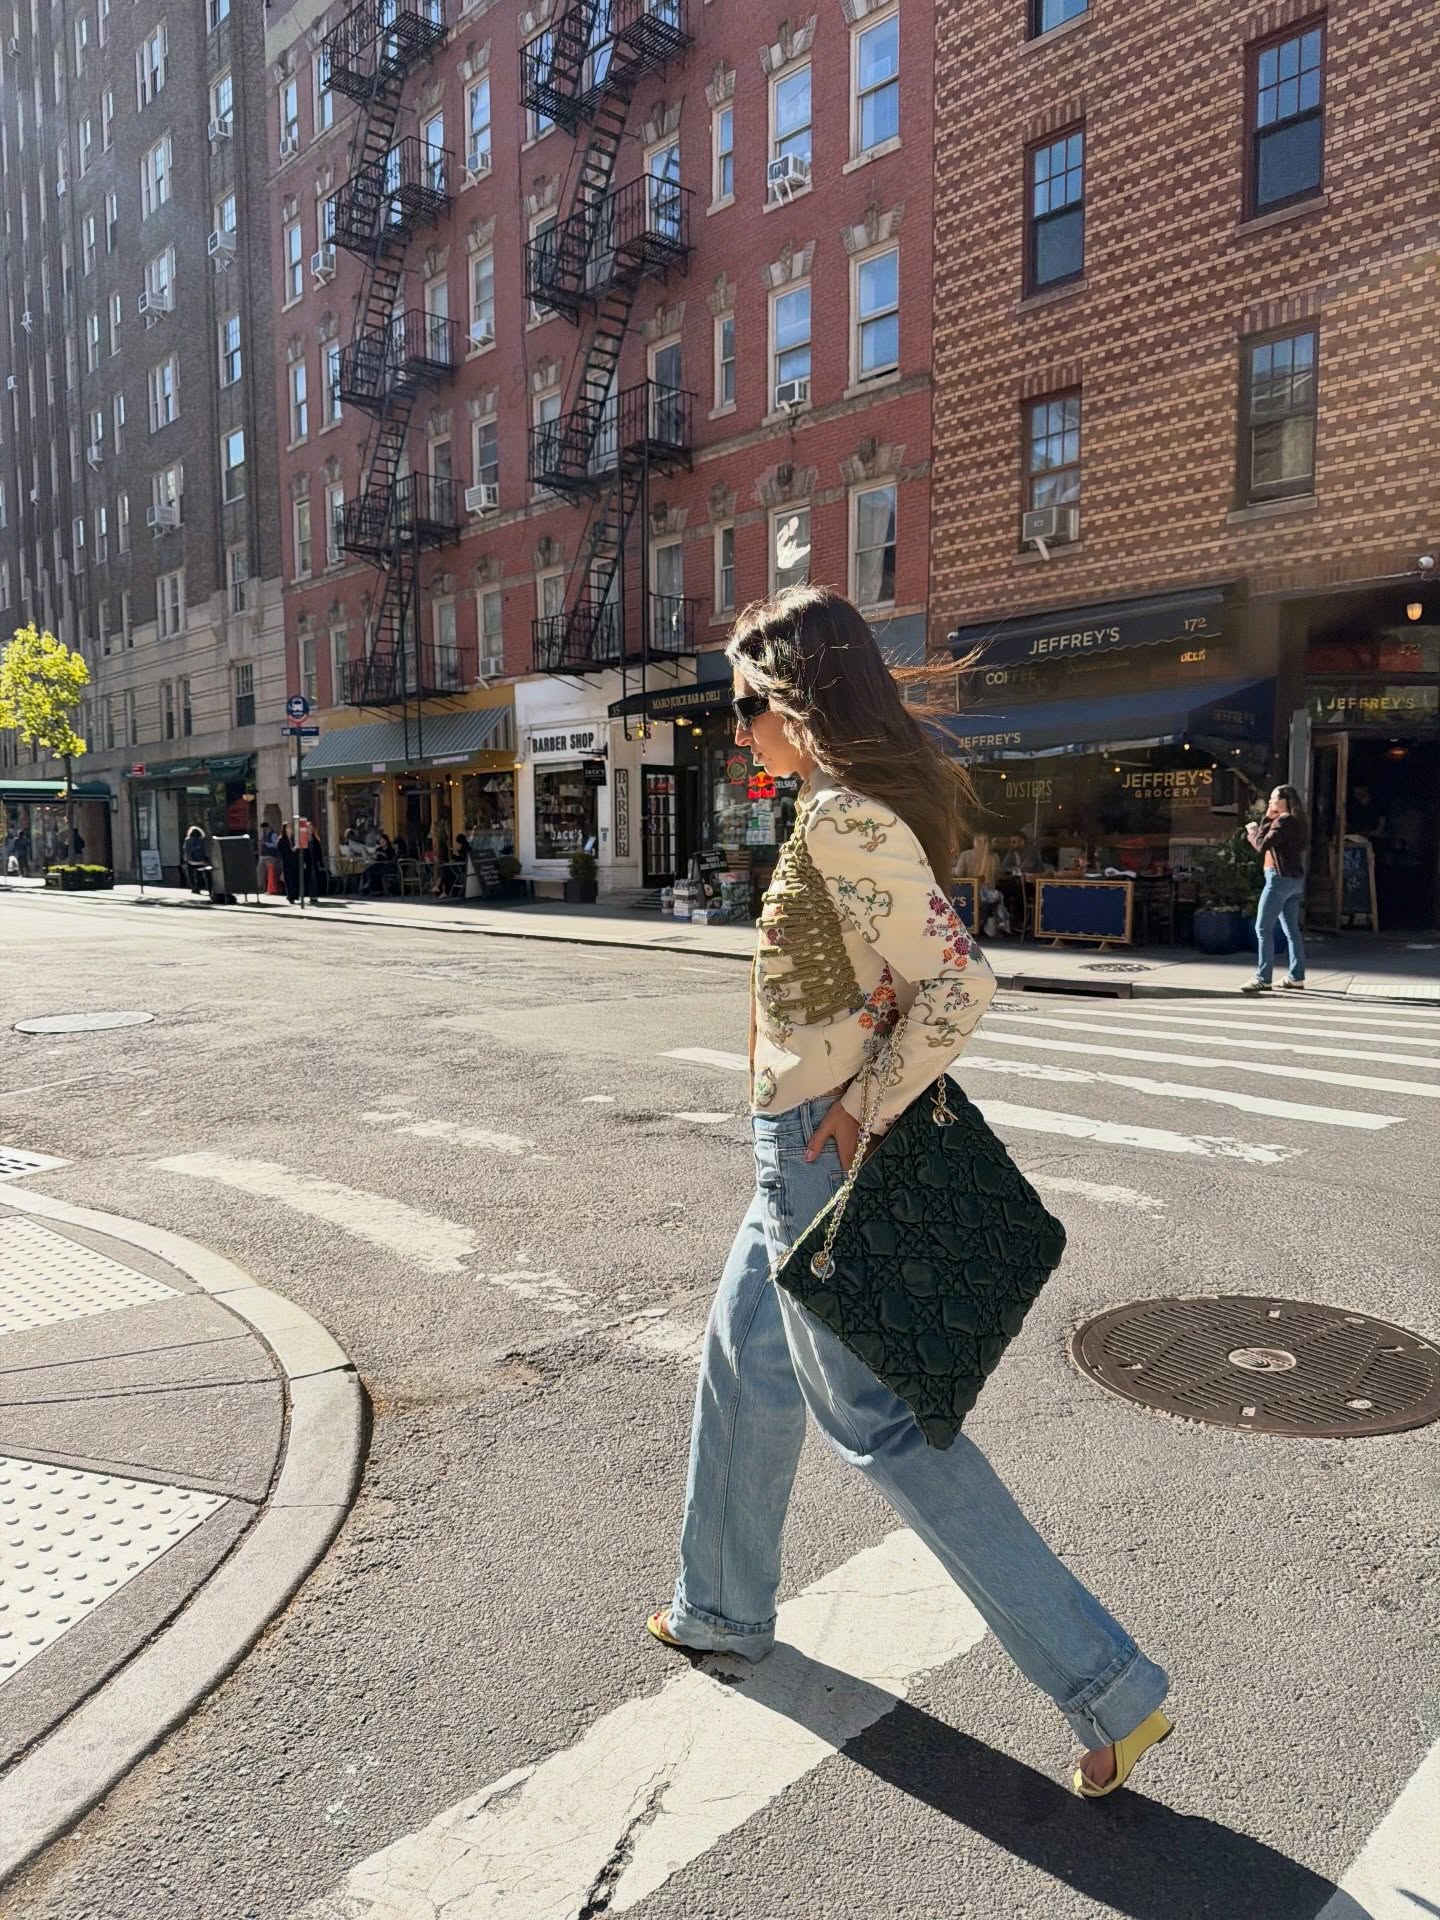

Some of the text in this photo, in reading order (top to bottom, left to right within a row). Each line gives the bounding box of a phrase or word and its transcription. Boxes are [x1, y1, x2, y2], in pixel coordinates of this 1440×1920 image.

[1184, 617, 1207, 632] 172
[1029, 627, 1120, 655] JEFFREY'S
[1326, 697, 1415, 710] JEFFREY'S
[532, 732, 594, 753] BARBER SHOP
[958, 732, 1021, 748] JEFFREY'S
[775, 779, 798, 789] CELSIUS
[1122, 769, 1213, 788] JEFFREY'S
[1006, 780, 1053, 798] OYSTERS
[1135, 787, 1199, 798] GROCERY
[617, 772, 626, 854] BARBER
[551, 829, 583, 840] JACK'S
